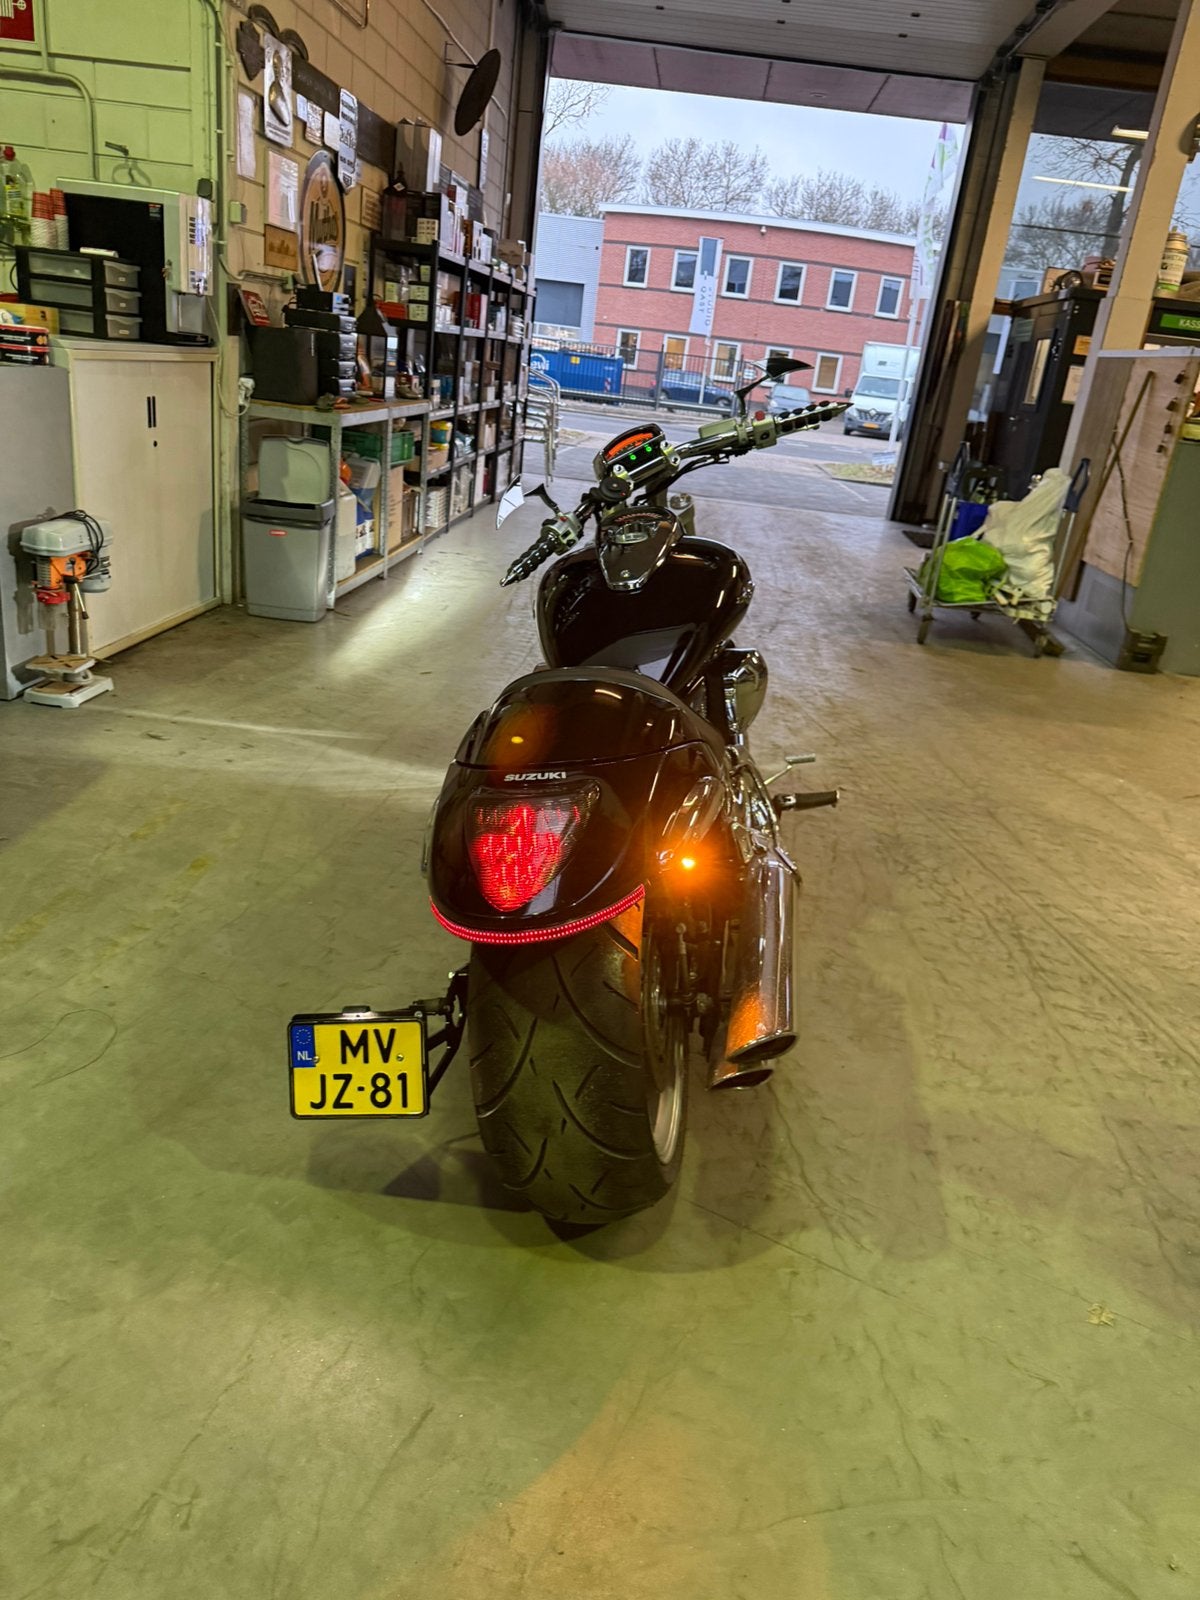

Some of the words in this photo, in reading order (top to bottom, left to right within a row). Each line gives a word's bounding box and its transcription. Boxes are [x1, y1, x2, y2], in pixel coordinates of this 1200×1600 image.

[503, 771, 567, 782] SUZUKI
[296, 1050, 313, 1061] NL
[340, 1028, 397, 1065] MV
[310, 1072, 408, 1110] JZ-81
